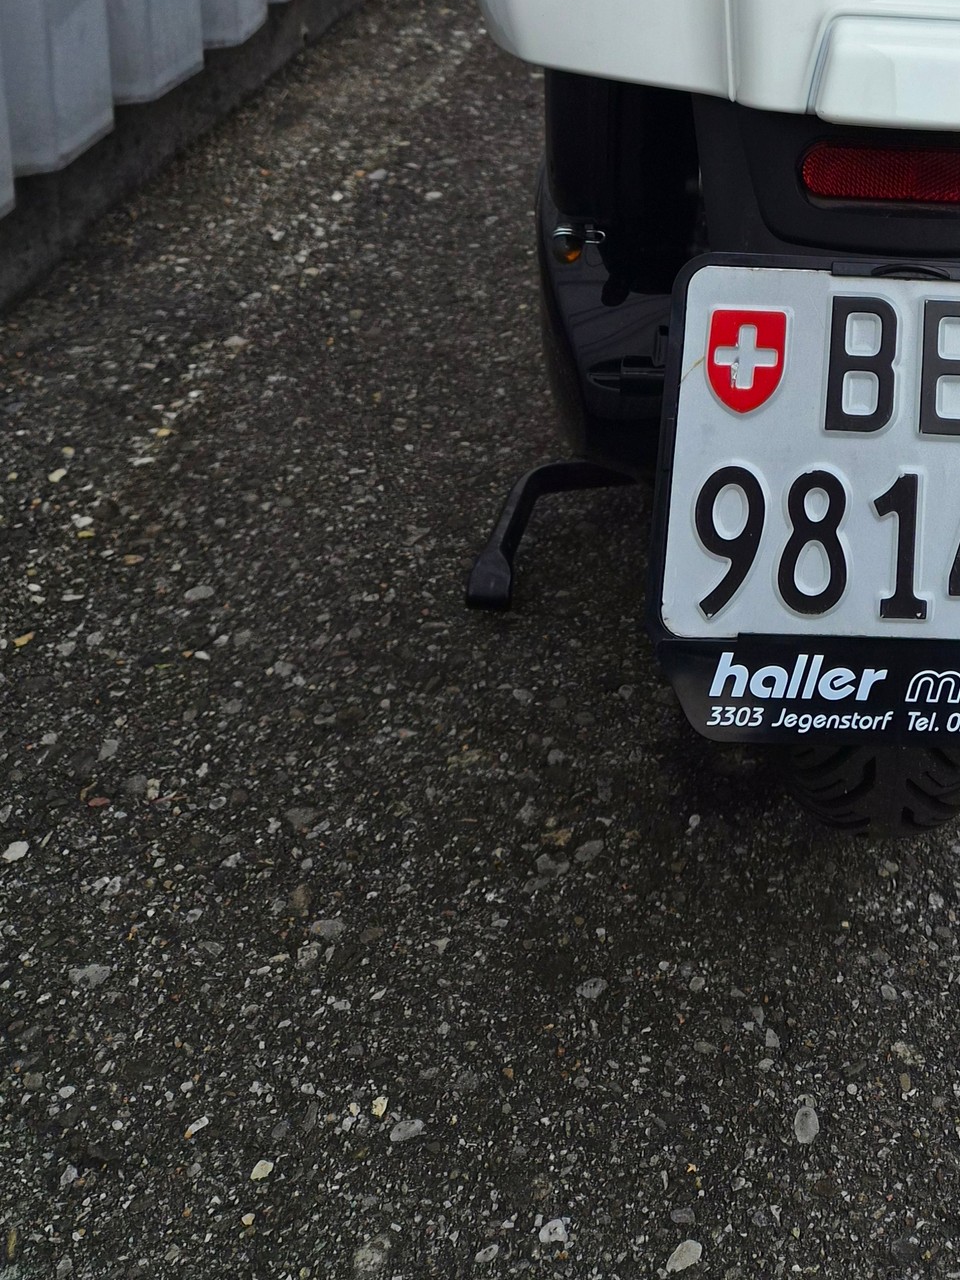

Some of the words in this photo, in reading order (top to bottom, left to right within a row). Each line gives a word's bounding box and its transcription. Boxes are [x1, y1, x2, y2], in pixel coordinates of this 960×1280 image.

[708, 652, 887, 701] haller
[706, 706, 764, 728] 3303
[771, 708, 893, 733] Jegenstorf
[908, 711, 940, 732] Tel.
